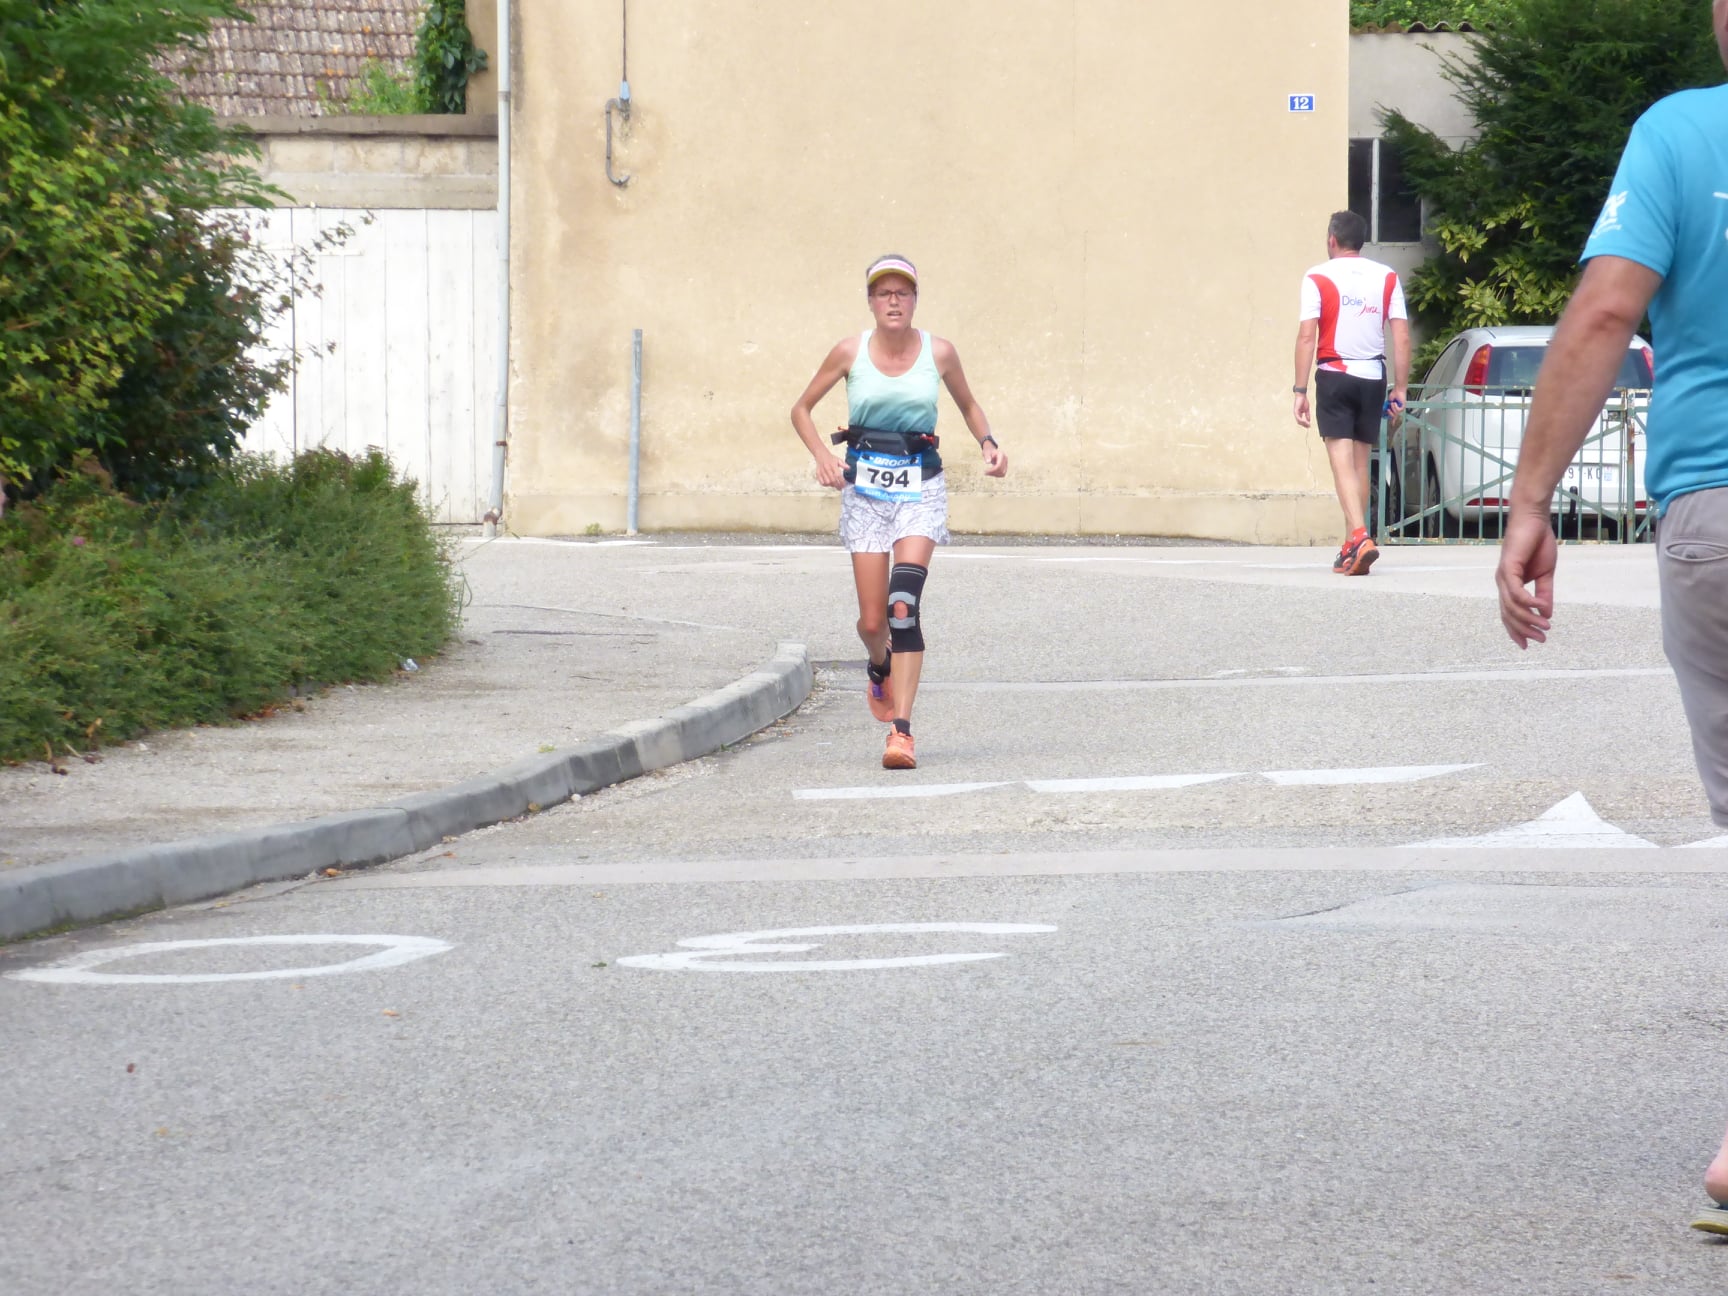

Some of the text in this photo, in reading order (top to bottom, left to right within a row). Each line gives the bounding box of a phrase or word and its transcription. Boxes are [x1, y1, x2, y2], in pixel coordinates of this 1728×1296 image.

[1293, 97, 1309, 110] 12
[1342, 295, 1363, 306] Dole
[867, 467, 910, 488] 794
